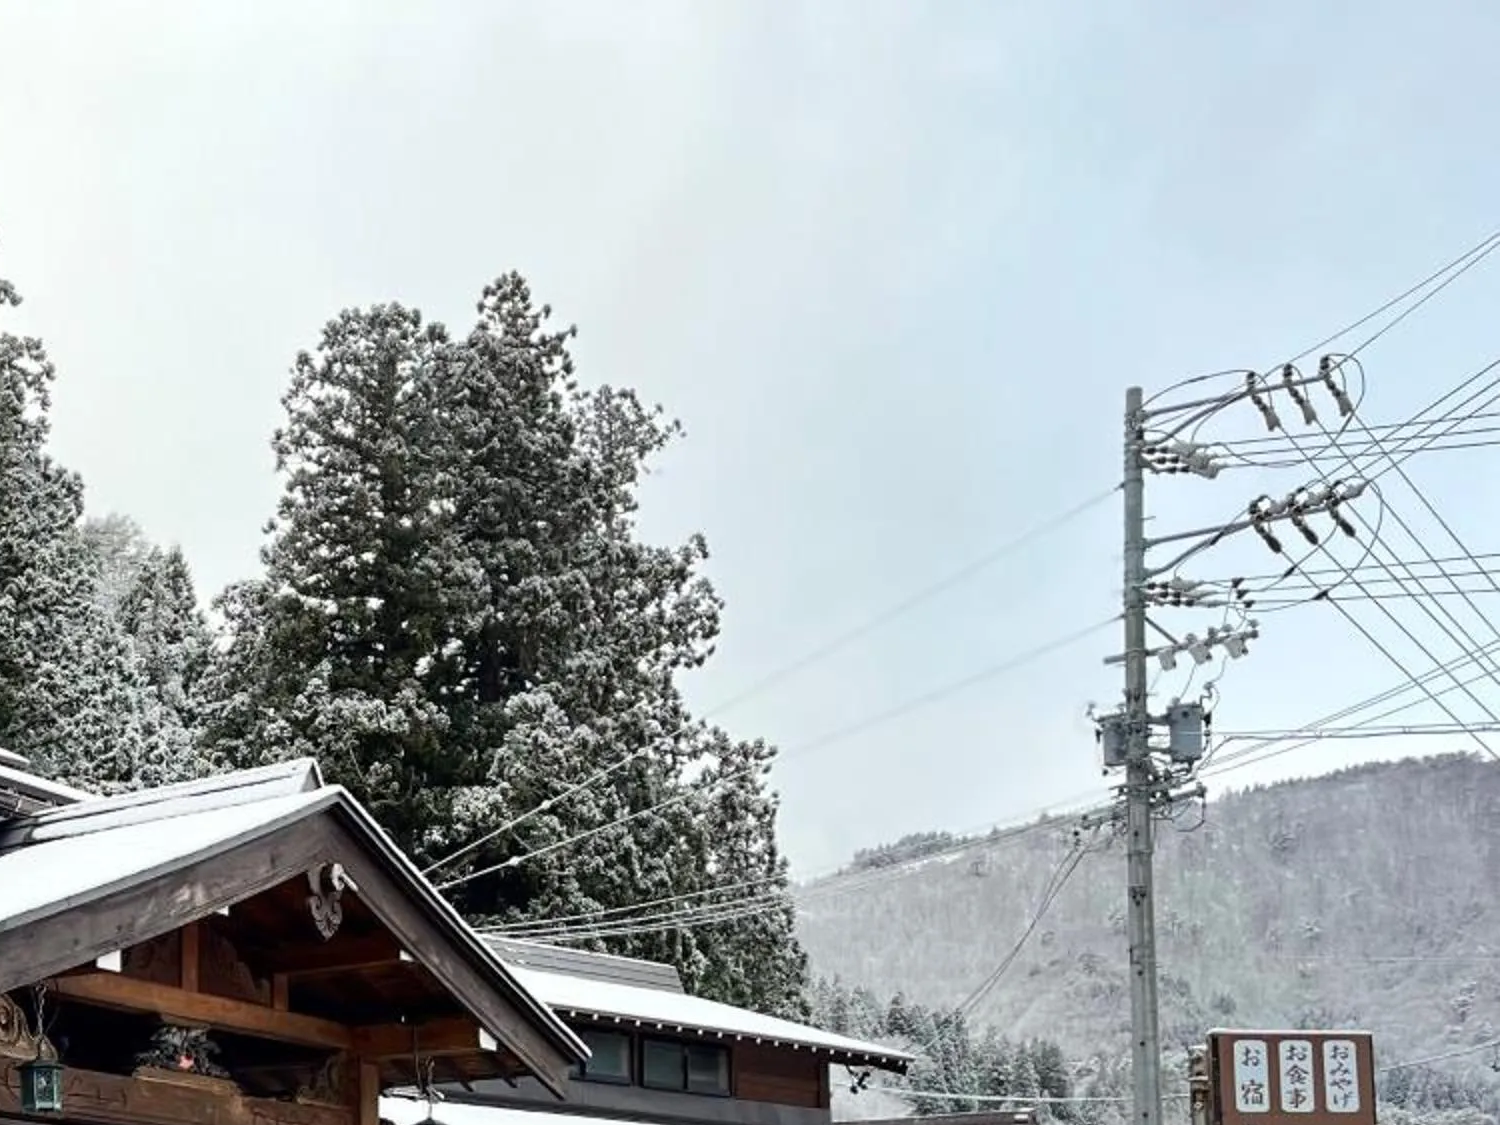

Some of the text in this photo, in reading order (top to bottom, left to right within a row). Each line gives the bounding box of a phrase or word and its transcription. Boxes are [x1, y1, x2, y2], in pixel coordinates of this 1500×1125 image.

[1241, 1046, 1264, 1105] お宿
[1285, 1044, 1309, 1108] お食事
[1329, 1044, 1353, 1108] おみやげ
